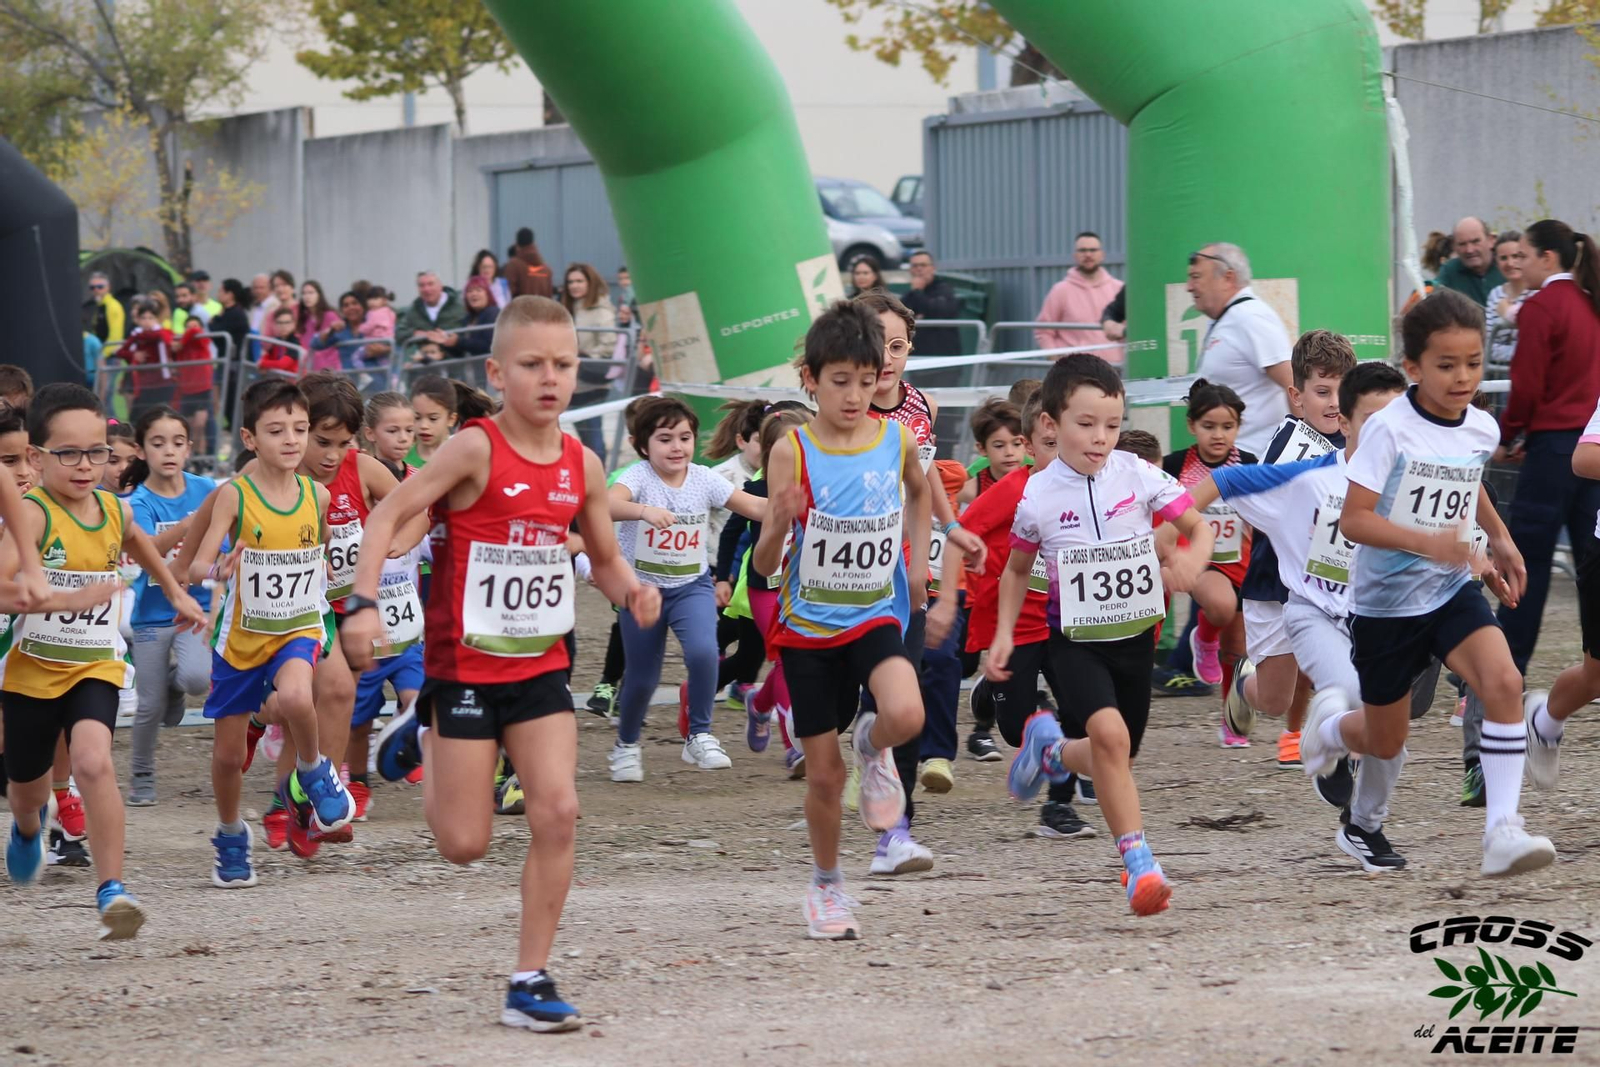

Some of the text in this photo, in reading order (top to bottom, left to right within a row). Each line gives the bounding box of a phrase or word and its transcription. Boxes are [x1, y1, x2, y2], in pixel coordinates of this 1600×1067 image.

[720, 308, 800, 337] DEPORTES
[1409, 485, 1471, 520] 1198
[817, 514, 834, 532] CROSS
[834, 518, 877, 534] INTERNACIONAL
[877, 517, 886, 531] DEL
[1059, 523, 1081, 531] mobel
[1414, 517, 1437, 528] Navas
[644, 527, 700, 551] 1204
[249, 551, 265, 566] CROSS
[265, 552, 301, 566] INTERNACIONAL
[483, 546, 505, 565] CROSS
[811, 537, 893, 570] 1408
[1062, 550, 1069, 565] 39
[1069, 548, 1088, 564] CROSS
[1088, 545, 1132, 563] INTERNACIONAL
[1131, 542, 1141, 558] DEL
[1320, 555, 1347, 568] TRIGO
[831, 571, 872, 579] ALFONSO
[1070, 564, 1154, 602] 1383
[247, 568, 315, 599] 1377
[808, 578, 849, 590] BELLON
[479, 574, 565, 611] 1065
[289, 604, 316, 617] SERRANO
[386, 601, 415, 627] 34
[1099, 601, 1128, 611] PEDRO
[501, 613, 538, 621] MACOVEI
[1073, 607, 1157, 625] FERNANDEZ LEON
[28, 631, 112, 646] CARDENAS HERRADOR
[60, 626, 87, 635] ADRIAN
[502, 626, 539, 635] ADRIAN
